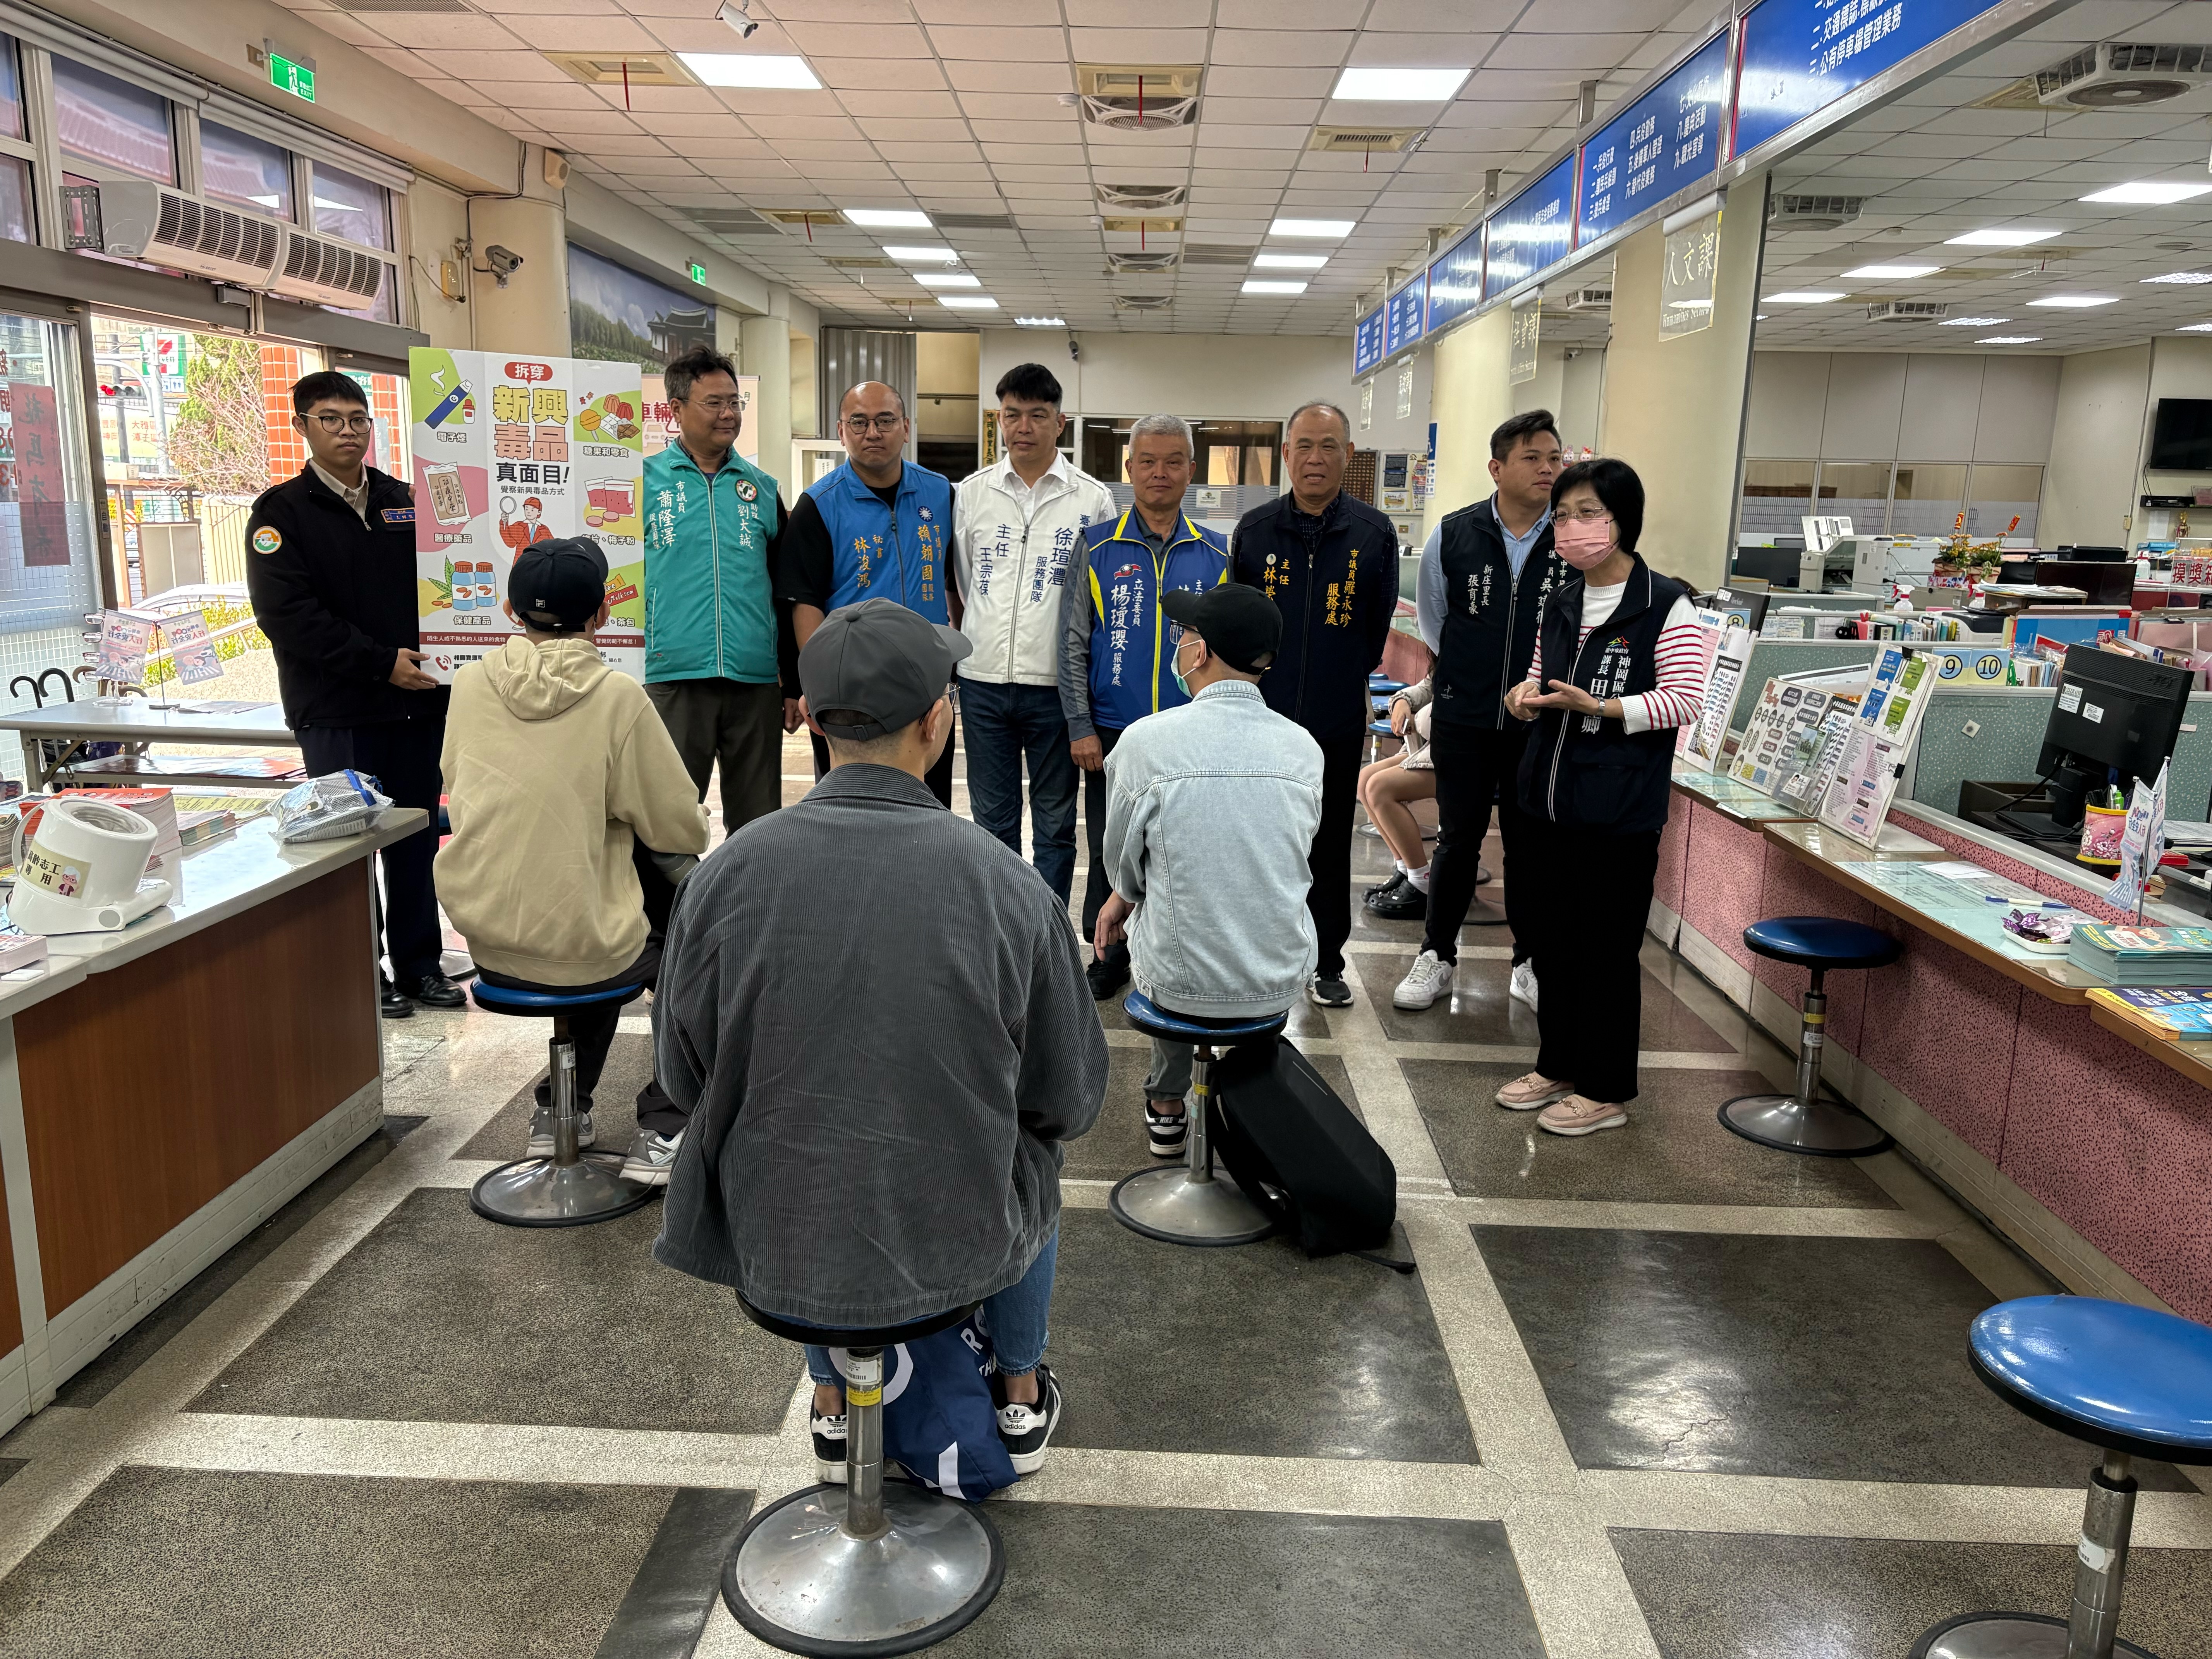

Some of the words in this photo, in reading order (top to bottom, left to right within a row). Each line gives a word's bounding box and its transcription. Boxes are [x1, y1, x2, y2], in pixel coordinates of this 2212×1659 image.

[301, 88, 312, 98] EXIT
[1665, 232, 1714, 291] 人文課
[515, 364, 544, 380] 拆穿
[493, 385, 568, 425] 新興
[437, 431, 467, 443] 電子煙
[494, 423, 568, 462] 毒品
[583, 445, 629, 458] 糖果和零食
[675, 481, 688, 513] 市議員
[657, 490, 677, 547] 蕭隆澤
[737, 504, 753, 550] 劉大誠
[434, 532, 472, 544] 醫療藥品
[917, 524, 934, 581] 賴朝國
[995, 524, 1012, 557] 主任
[1030, 556, 1048, 603] 服務團隊
[1279, 559, 1290, 585] 主任
[1481, 564, 1493, 606] 新庄里長
[1131, 578, 1144, 627] 立法委員
[1324, 583, 1341, 626] 服務處
[1467, 574, 1479, 615] 張育豪
[453, 615, 491, 625] 保健產品
[1110, 584, 1131, 651] 楊瓊瓔
[1111, 653, 1122, 687] 服務處
[1597, 654, 1612, 675] 課長
[1945, 659, 1956, 675] 9
[1979, 659, 1998, 675] 10
[27, 850, 61, 875] 高齡志工
